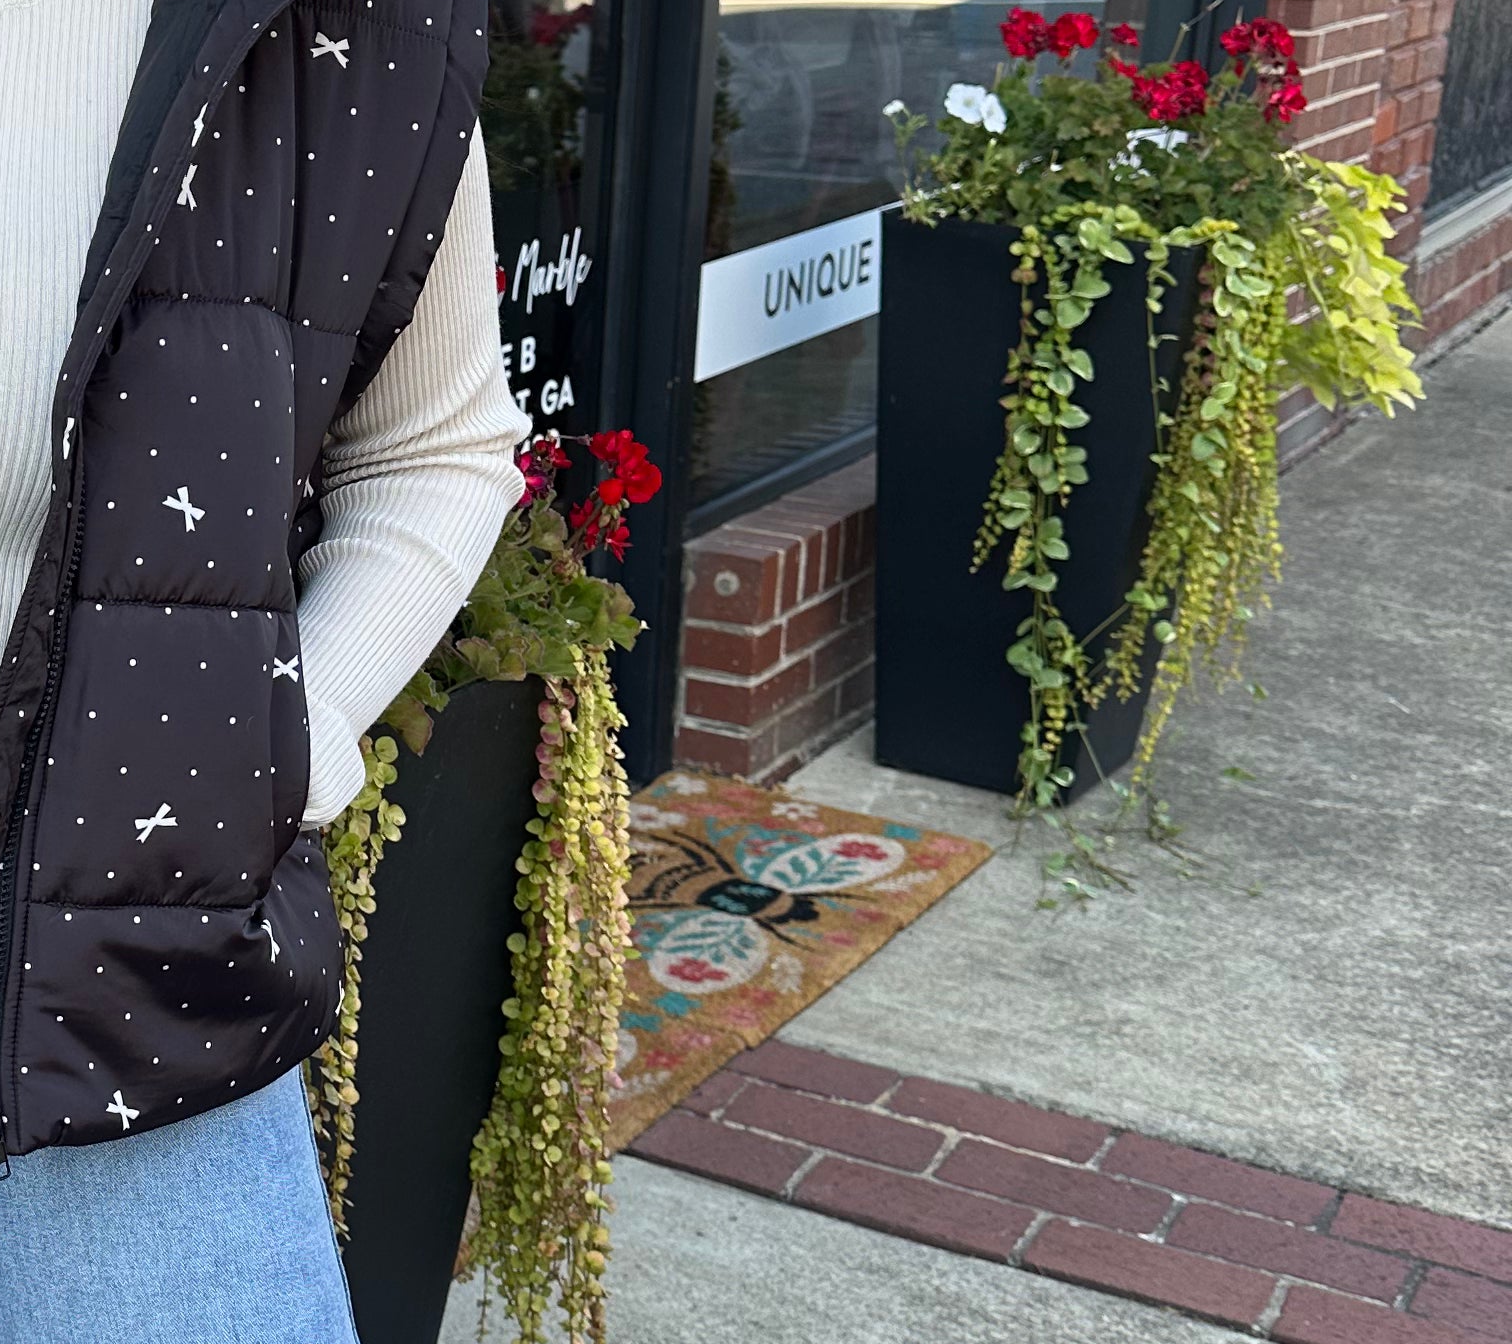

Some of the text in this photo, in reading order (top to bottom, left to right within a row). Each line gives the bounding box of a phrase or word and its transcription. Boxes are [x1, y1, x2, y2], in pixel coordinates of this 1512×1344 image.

[511, 226, 593, 315] Marble
[764, 239, 874, 318] UNIQUE
[540, 374, 576, 416] GA
